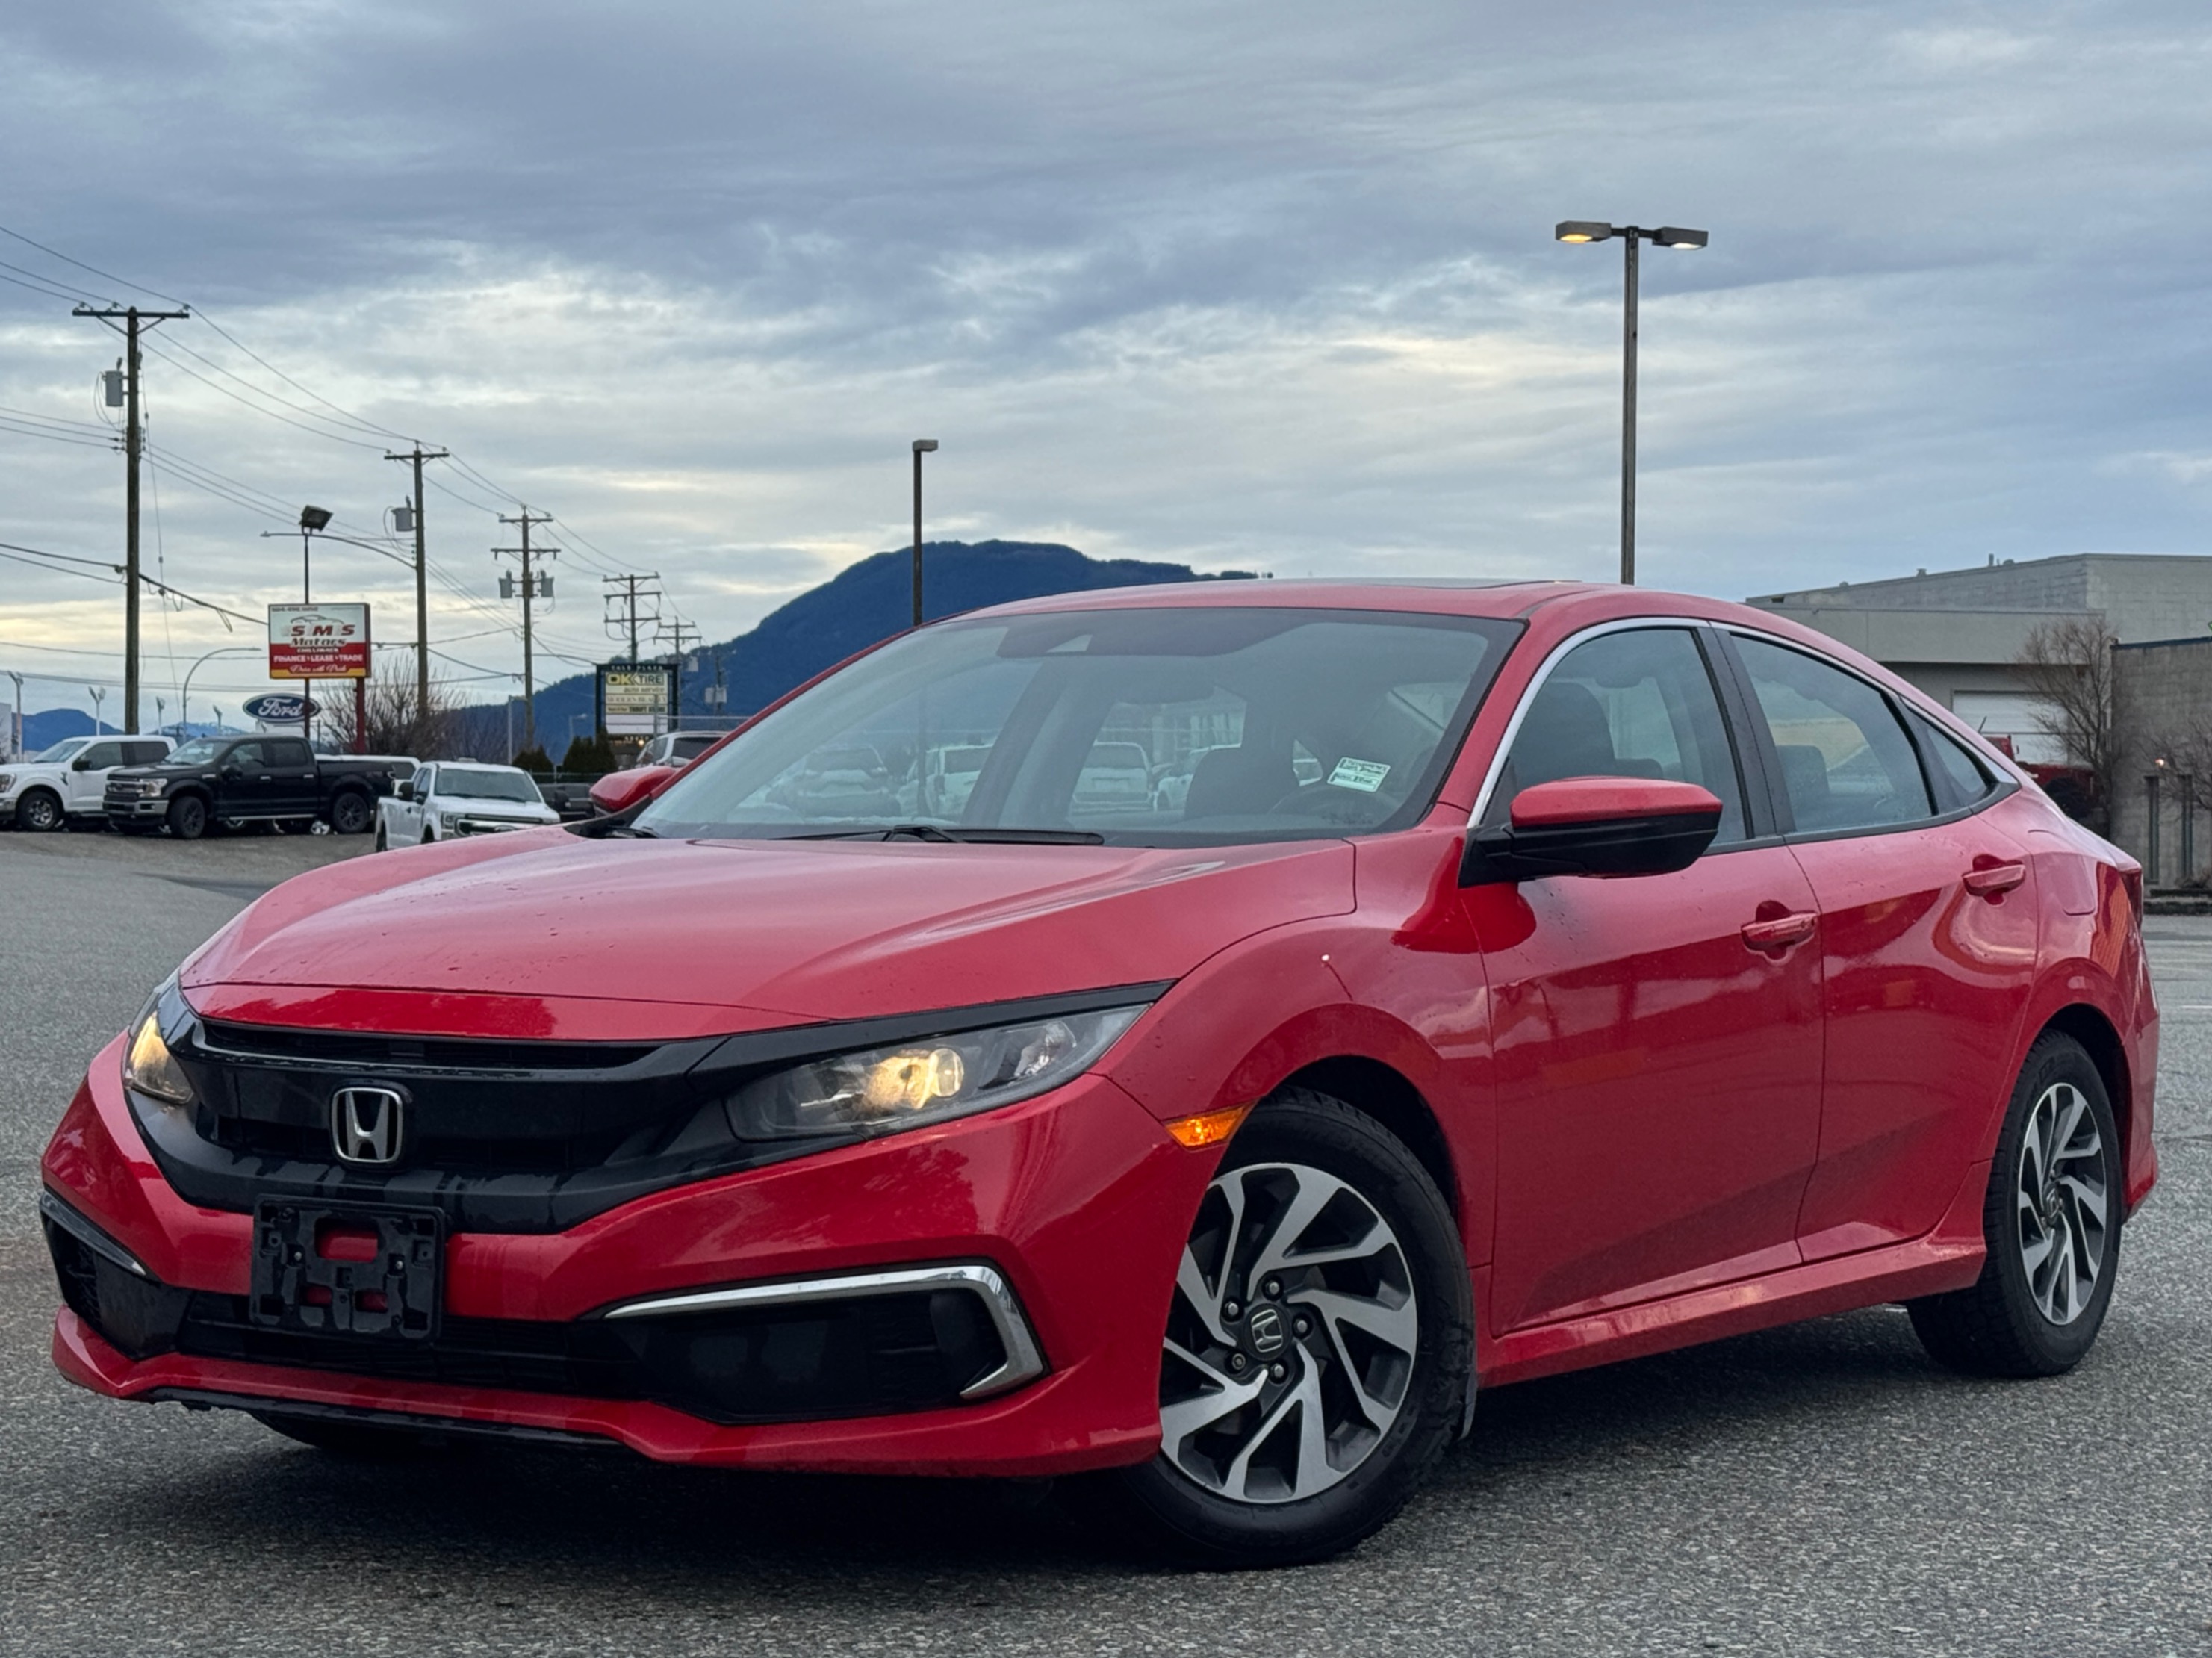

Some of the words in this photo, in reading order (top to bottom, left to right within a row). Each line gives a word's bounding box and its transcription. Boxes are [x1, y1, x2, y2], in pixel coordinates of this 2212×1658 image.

[291, 638, 347, 646] Motors
[607, 674, 631, 684] OK
[639, 675, 661, 683] TIRE
[258, 698, 303, 716] Ford
